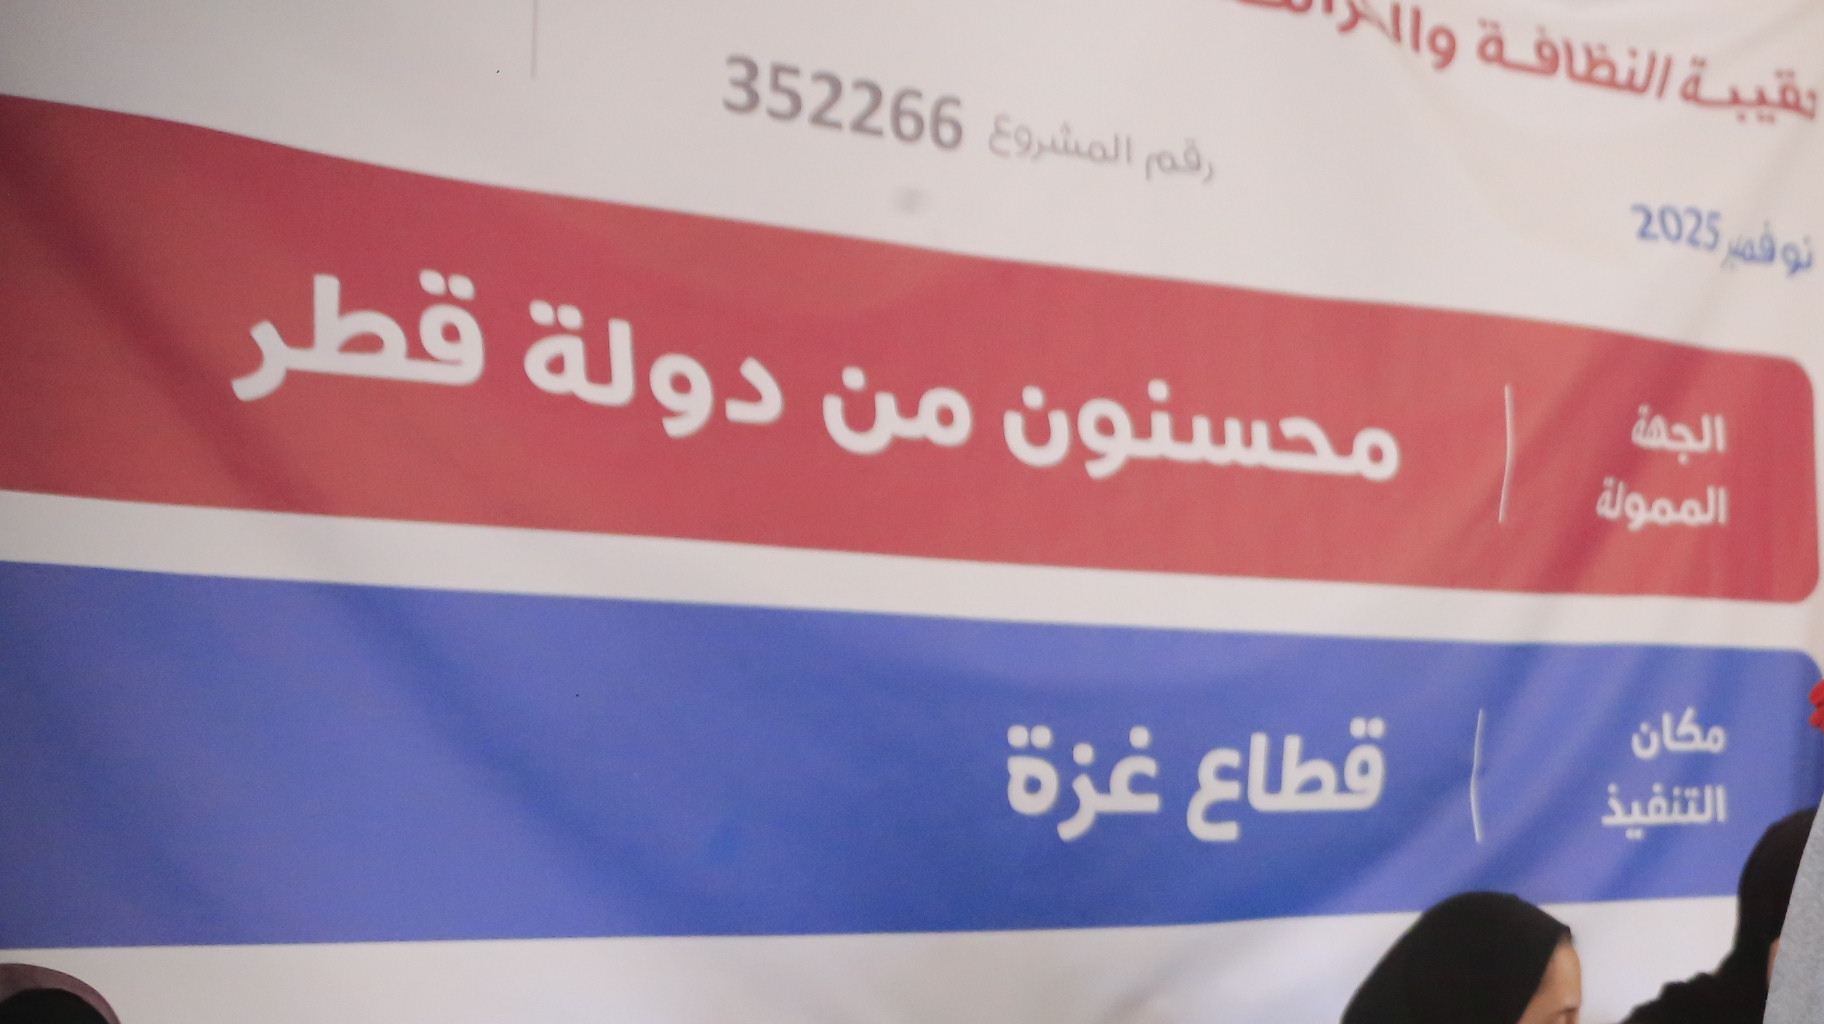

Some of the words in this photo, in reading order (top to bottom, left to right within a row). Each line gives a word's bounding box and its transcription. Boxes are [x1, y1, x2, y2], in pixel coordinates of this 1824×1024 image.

[1476, 18, 1673, 101] النظافة
[722, 54, 964, 151] 352266
[987, 113, 1133, 165] المشروع
[1144, 139, 1215, 183] رقم
[1632, 204, 1719, 252] 2025
[1720, 220, 1815, 278] نوفمبر
[231, 269, 486, 401] قطر
[523, 300, 784, 439] دولة
[822, 366, 974, 455] من
[1003, 379, 1401, 482] محسنون
[1631, 405, 1727, 465] الجهة
[1596, 478, 1728, 532] الممولة
[1631, 706, 1727, 761] مكان
[1006, 724, 1162, 841] غزة
[1186, 716, 1387, 842] قطاع
[1601, 782, 1728, 840] التنفيذ
